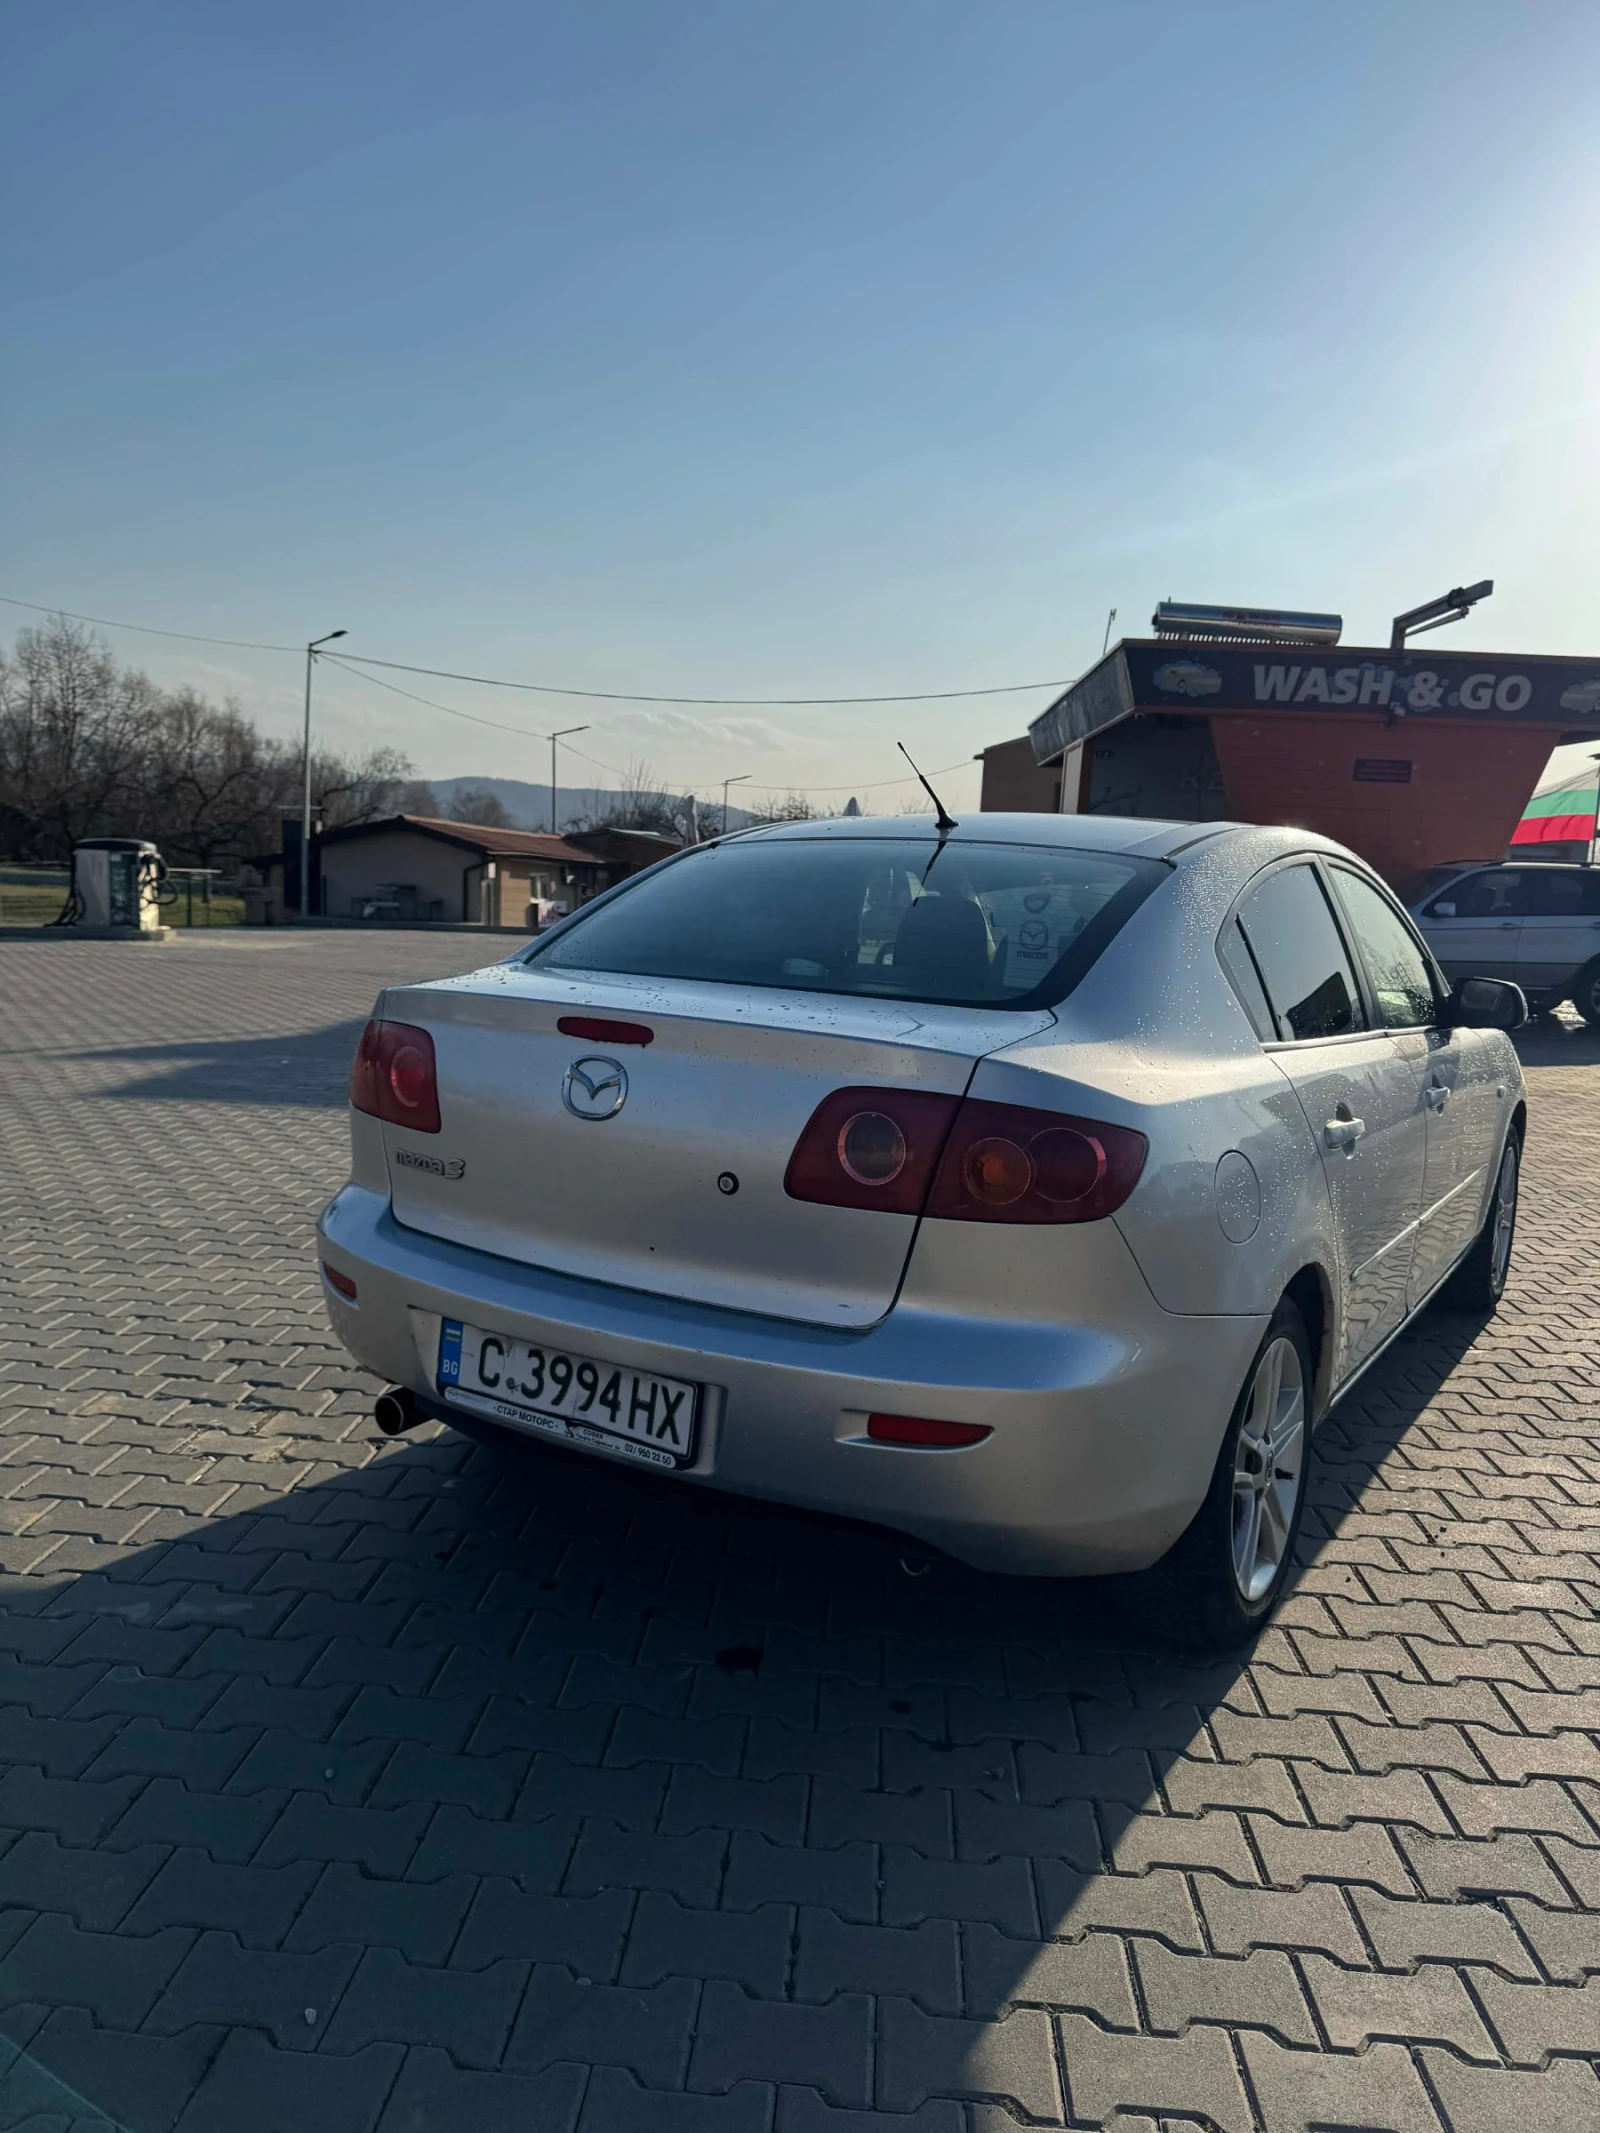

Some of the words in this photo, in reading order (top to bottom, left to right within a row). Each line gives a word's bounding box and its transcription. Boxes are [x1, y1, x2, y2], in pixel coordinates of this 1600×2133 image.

[1253, 664, 1396, 706] WASH
[1408, 671, 1445, 708] &
[1459, 674, 1533, 711] GO
[443, 1358, 459, 1375] BG
[519, 1411, 554, 1428] МОТОРС
